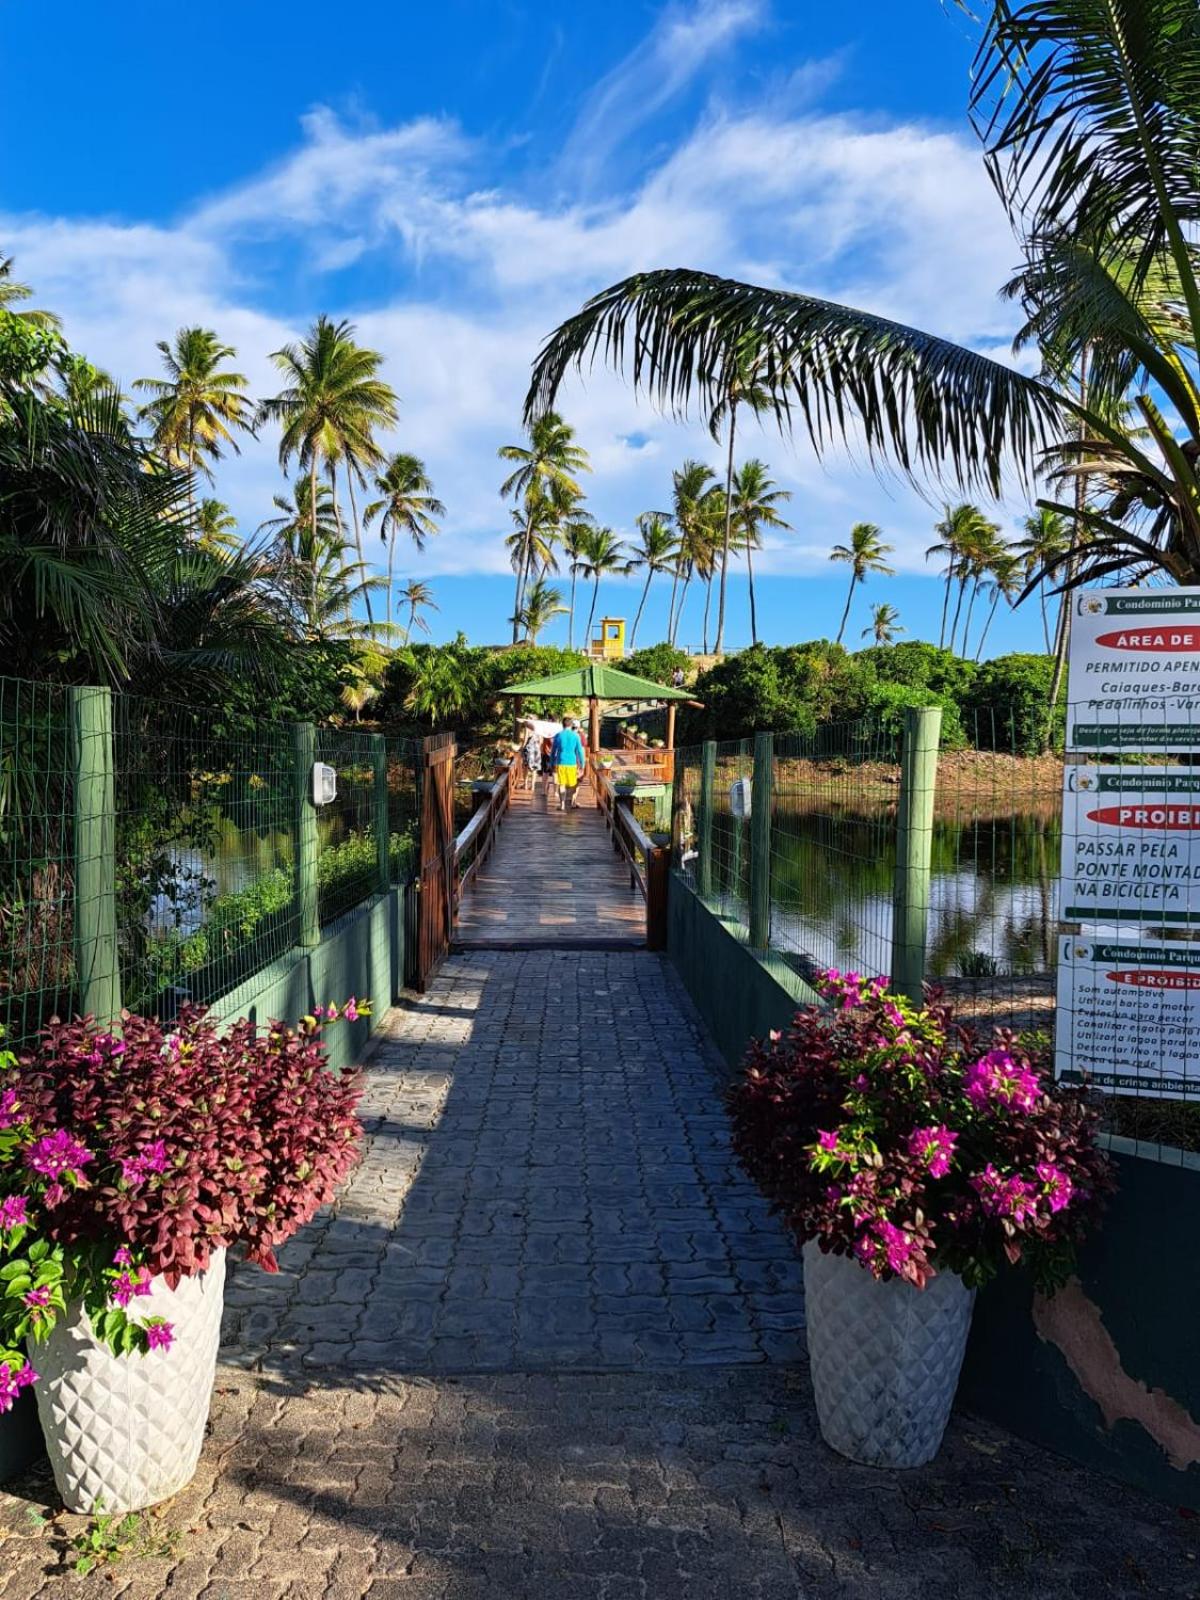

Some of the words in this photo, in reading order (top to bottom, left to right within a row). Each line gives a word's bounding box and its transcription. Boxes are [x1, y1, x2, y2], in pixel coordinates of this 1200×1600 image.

[1116, 632, 1164, 647] ÁREA
[1170, 635, 1193, 645] DE
[1085, 661, 1160, 673] PERMITIDO
[1163, 661, 1200, 672] APEN
[1088, 699, 1166, 710] Pedalinhos
[1077, 842, 1136, 857] PASSAR
[1141, 843, 1178, 858] PELA
[1076, 862, 1129, 877] PONTE
[1133, 864, 1200, 879] MONTAD
[1076, 882, 1097, 897] NA
[1102, 883, 1180, 899] BICICLETA
[1078, 985, 1101, 993] Som
[1104, 988, 1165, 998] automotivo
[1078, 997, 1117, 1006] Utilizar
[1120, 1000, 1150, 1009] barco
[1161, 1003, 1195, 1011] motor
[1131, 1012, 1155, 1021] para
[1077, 1020, 1127, 1030] Canalizar
[1130, 1024, 1165, 1034] esgoto
[1168, 1027, 1193, 1036] para
[1127, 1034, 1157, 1044] lagoa
[1160, 1039, 1186, 1047] para
[1077, 1042, 1128, 1053] Descartar
[1119, 1079, 1149, 1088] crime
